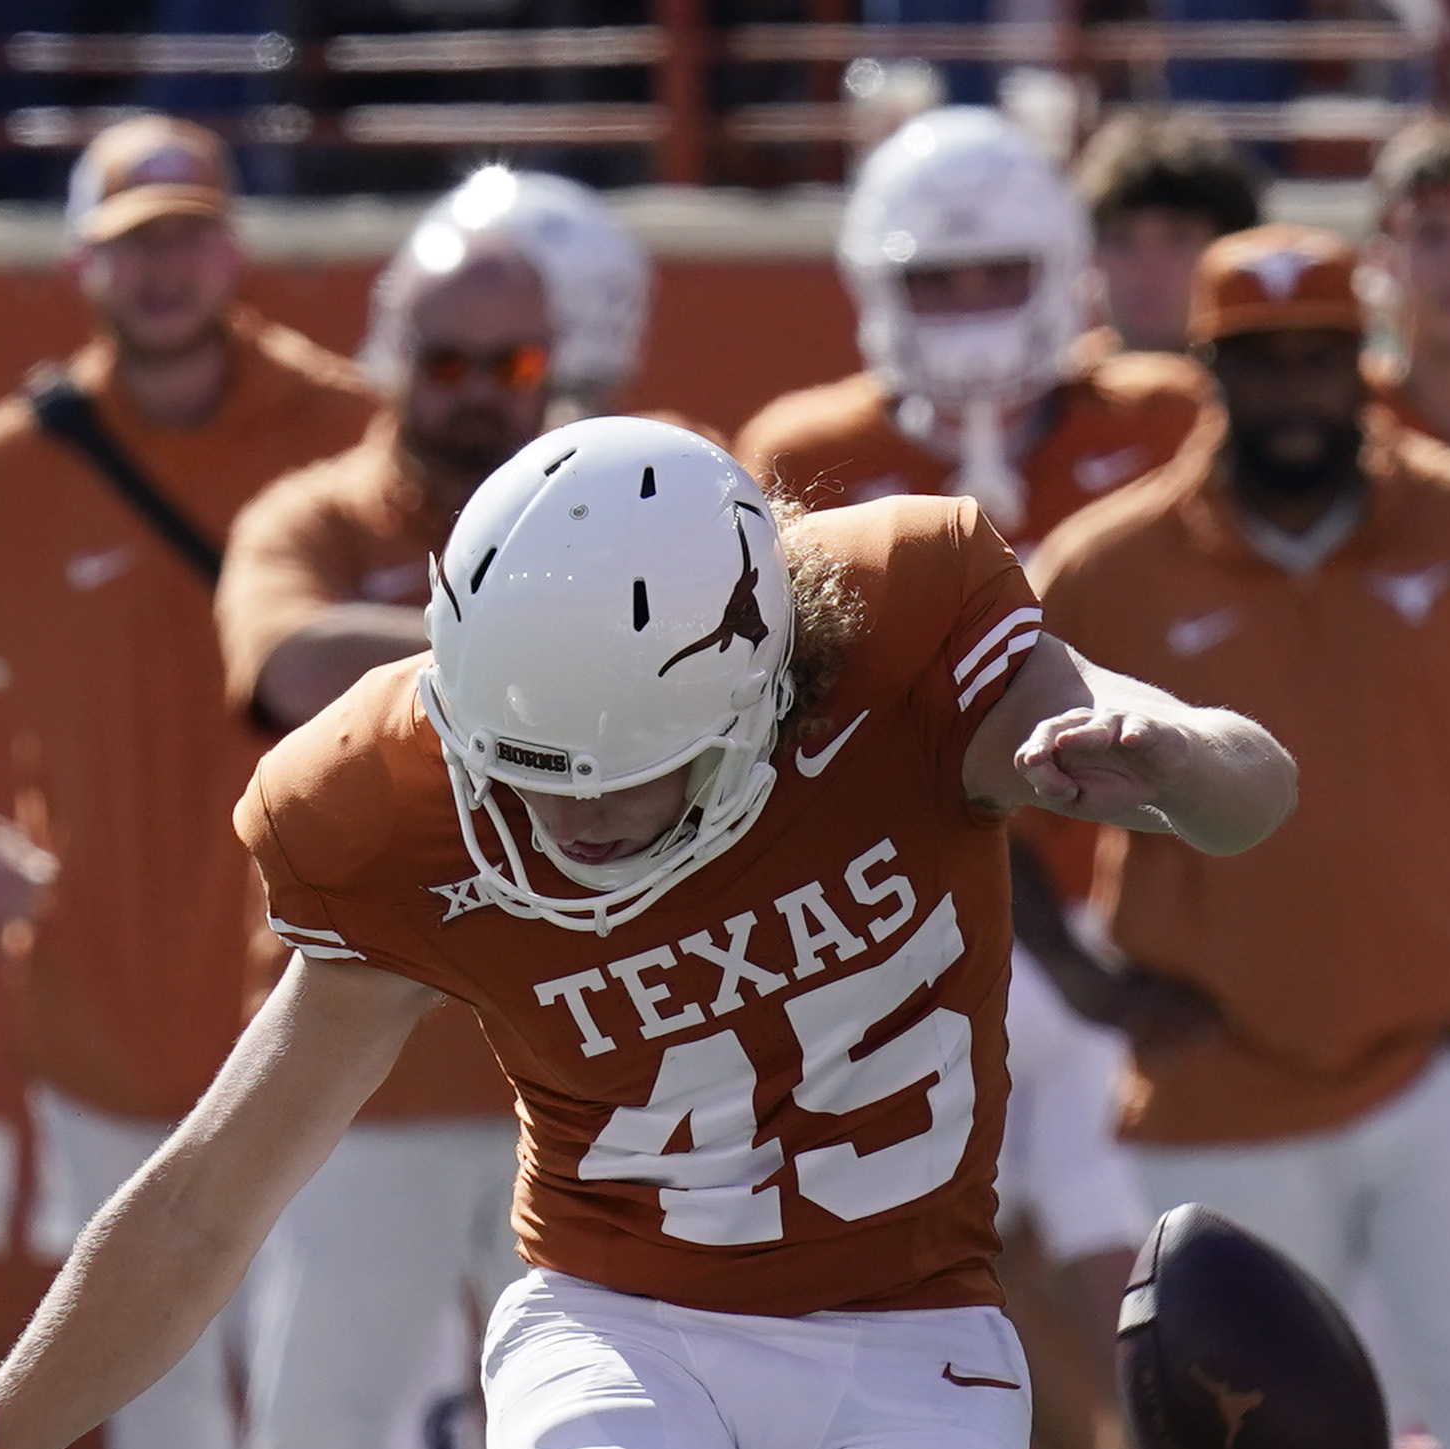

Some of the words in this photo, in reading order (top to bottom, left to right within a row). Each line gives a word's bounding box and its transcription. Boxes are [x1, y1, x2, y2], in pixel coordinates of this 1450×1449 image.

[496, 741, 568, 773] HORNS
[533, 837, 917, 1058] TEXAS
[577, 891, 976, 1246] 45
